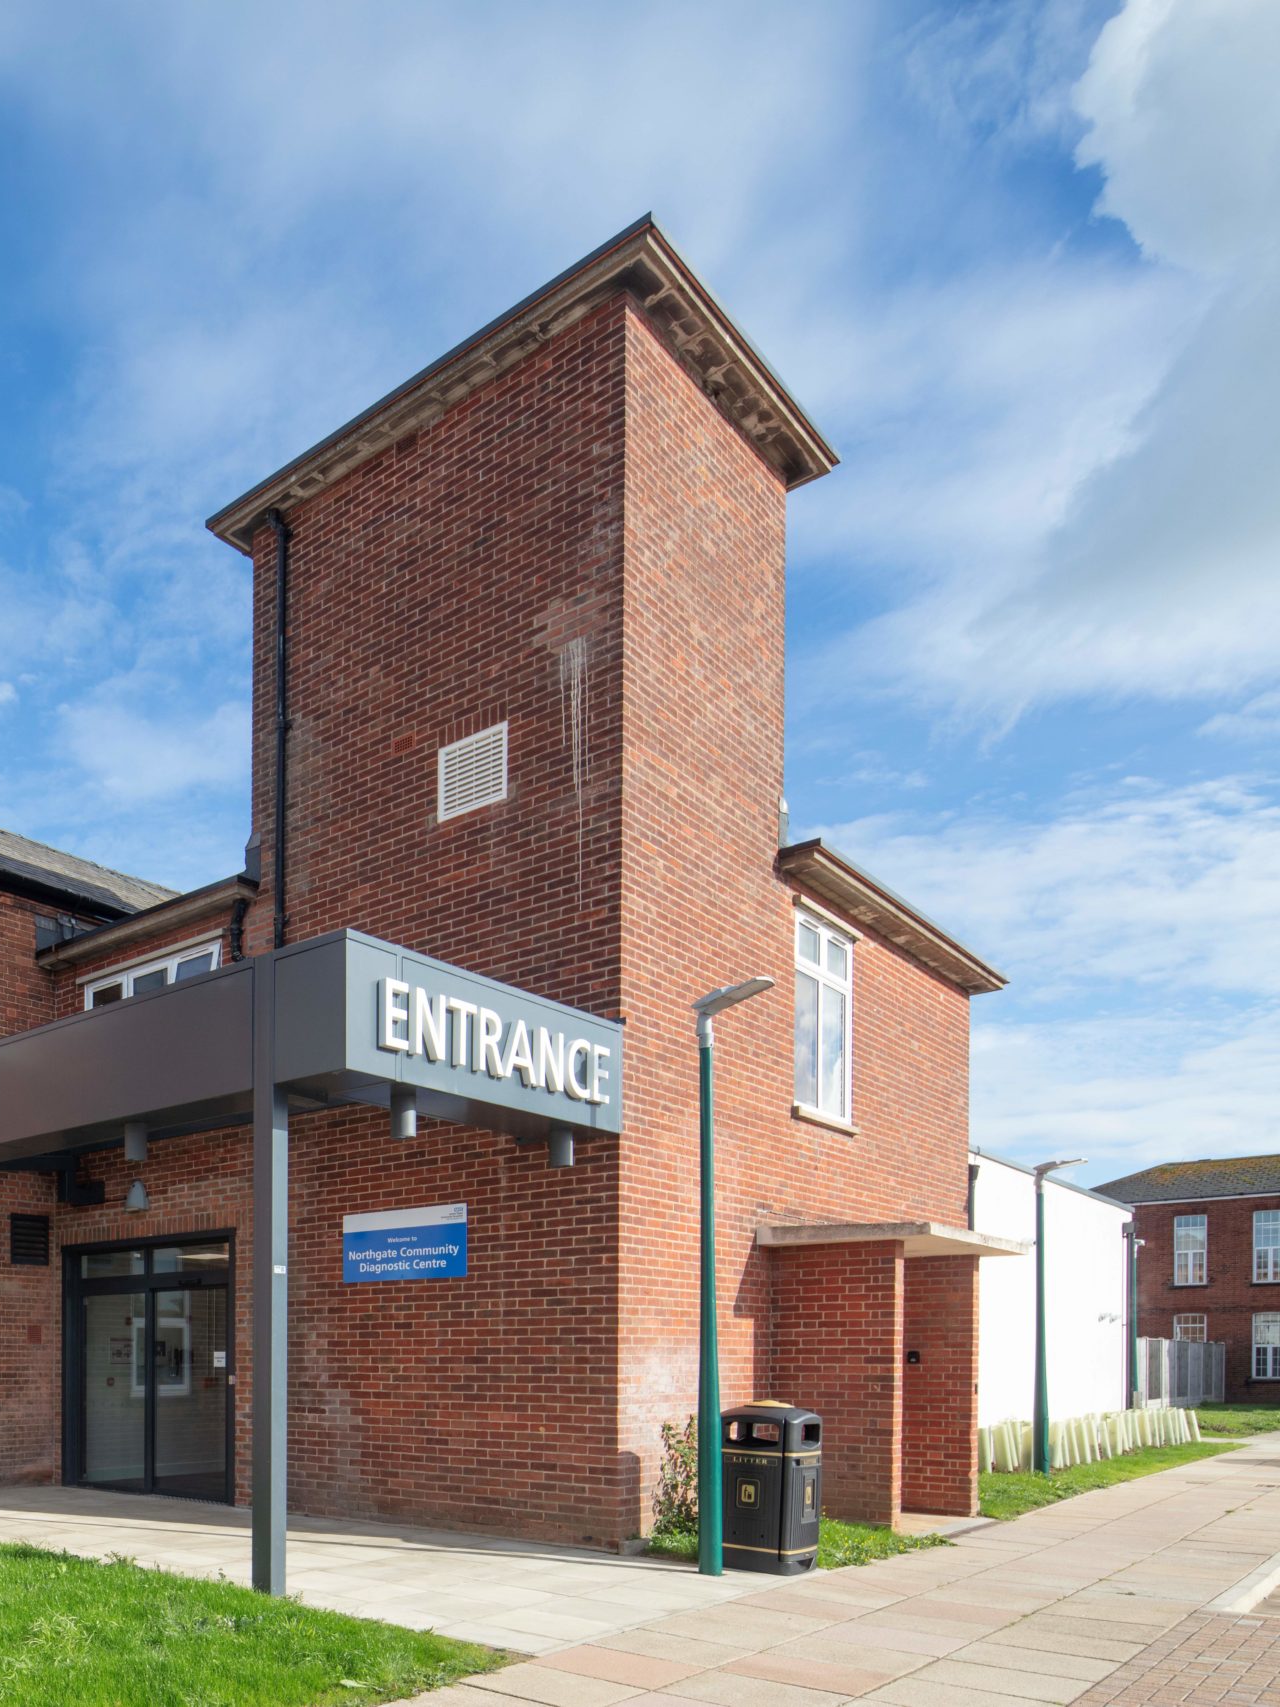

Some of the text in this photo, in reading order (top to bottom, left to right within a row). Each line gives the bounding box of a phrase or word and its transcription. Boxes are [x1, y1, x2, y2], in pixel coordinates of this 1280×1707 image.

[378, 976, 611, 1105] ENTRANCE
[348, 1244, 459, 1261] Northgate Community
[360, 1258, 446, 1274] Diagnostic Centre
[733, 1456, 768, 1464] LITTER
